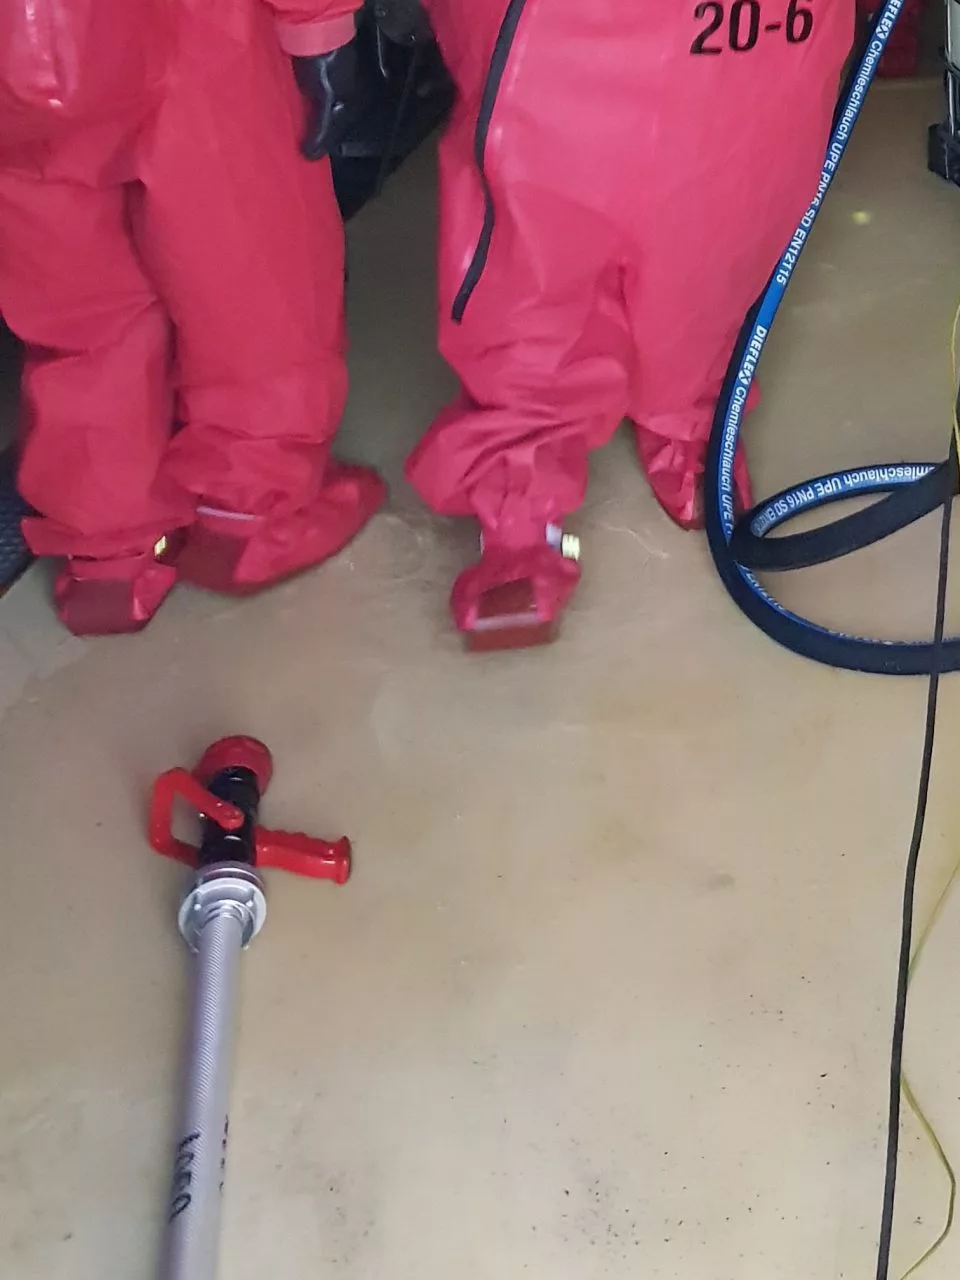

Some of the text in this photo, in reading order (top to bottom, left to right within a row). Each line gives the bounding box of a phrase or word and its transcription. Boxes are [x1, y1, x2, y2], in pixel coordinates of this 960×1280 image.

[836, 40, 883, 141] Chemieschlauch
[824, 141, 843, 172] UPE
[776, 227, 807, 287] EN12115
[737, 324, 768, 386] DIEFLEX
[722, 386, 748, 493] Chemieschlauch
[789, 488, 815, 509] PN16
[816, 480, 843, 498] UPE
[844, 465, 935, 487] mieschlauch
